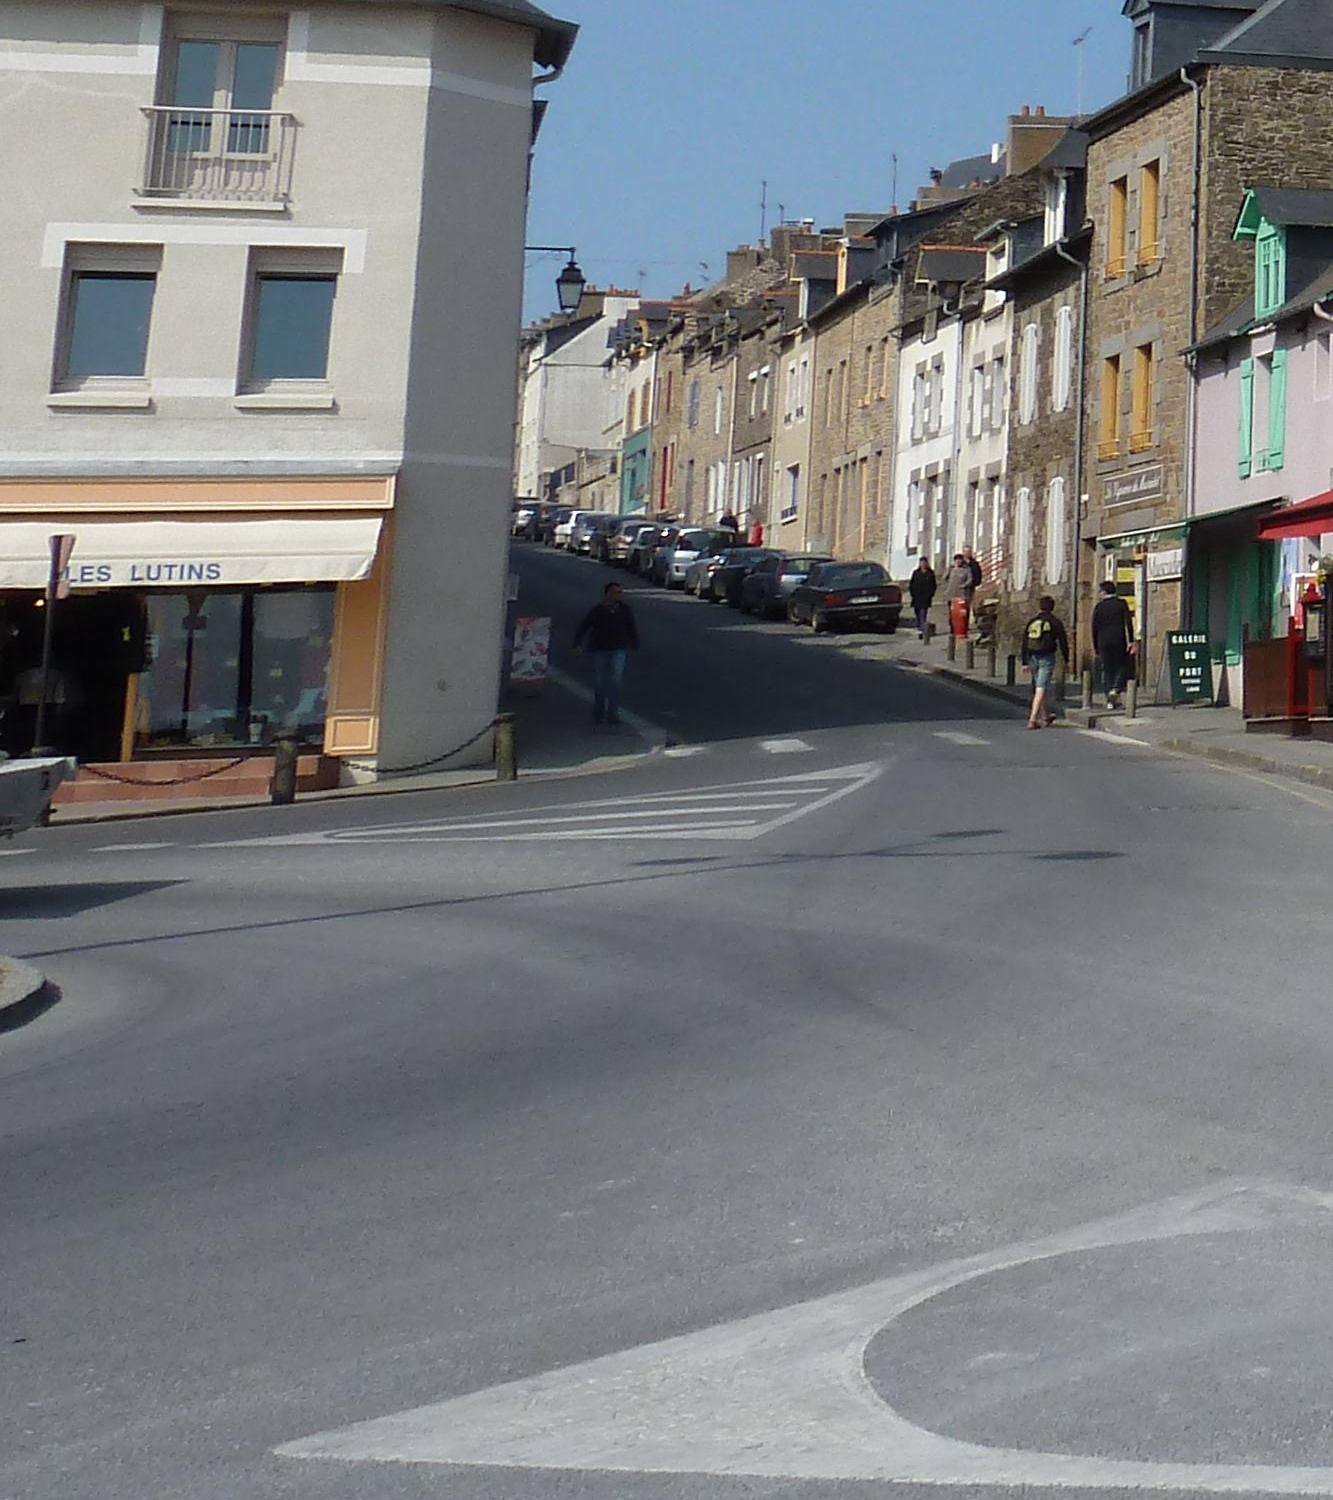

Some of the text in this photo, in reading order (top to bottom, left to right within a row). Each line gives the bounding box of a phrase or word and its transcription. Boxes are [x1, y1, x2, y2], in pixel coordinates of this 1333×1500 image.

[65, 563, 222, 583] LES LUTINS
[1171, 634, 1207, 644] GALERIE
